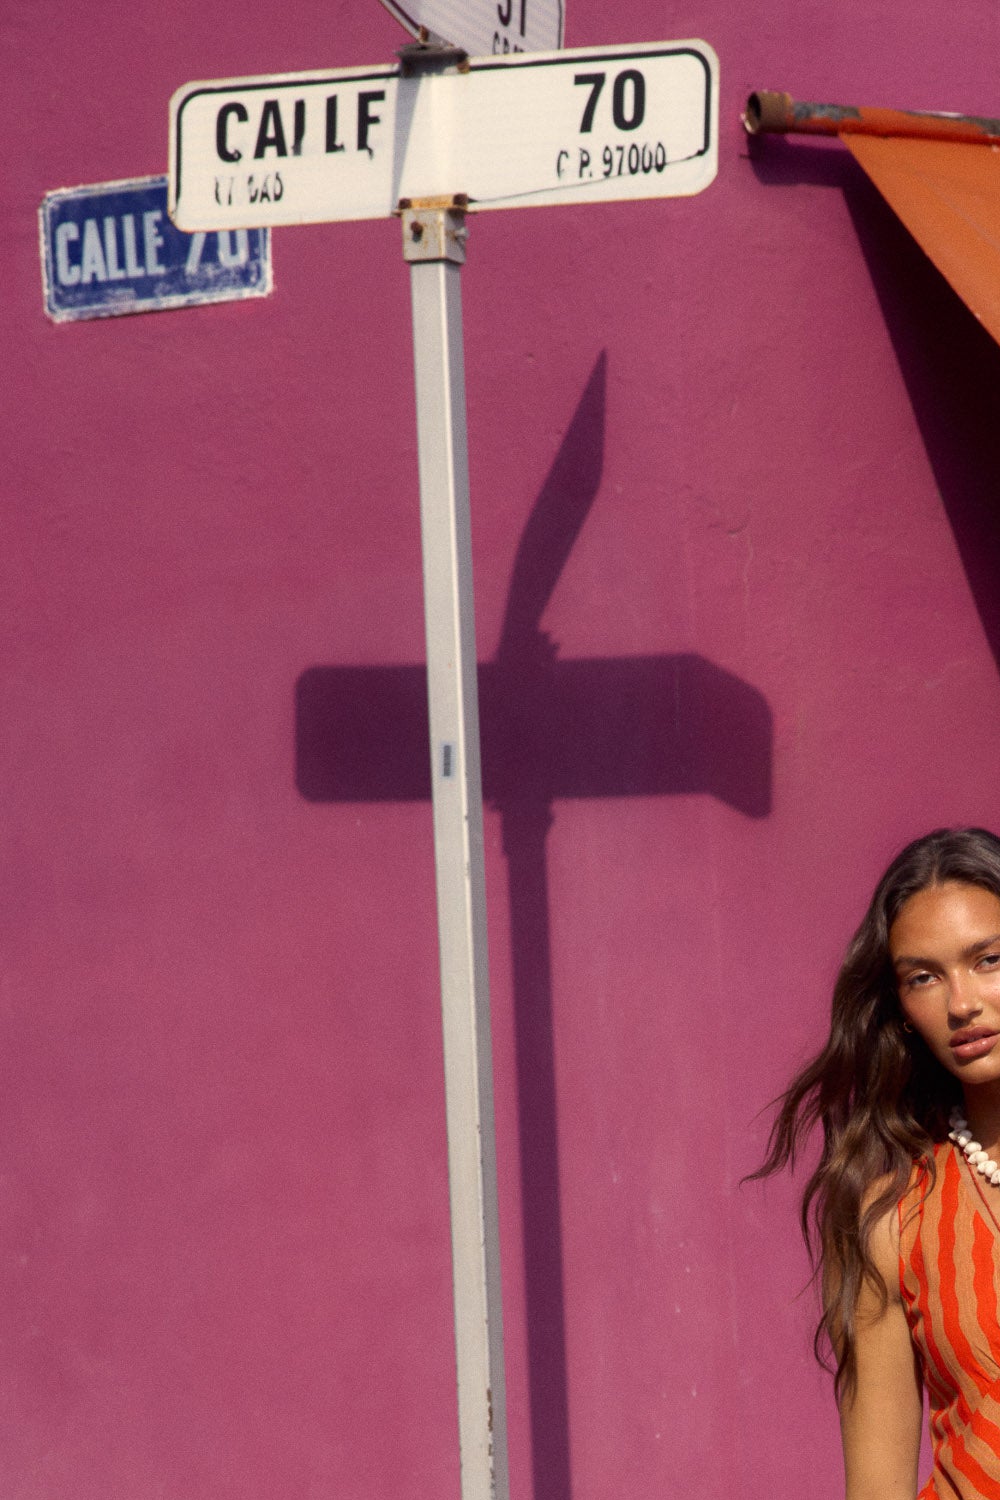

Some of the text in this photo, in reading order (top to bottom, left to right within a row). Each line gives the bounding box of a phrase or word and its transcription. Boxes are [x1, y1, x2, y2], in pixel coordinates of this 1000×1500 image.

[574, 69, 646, 133] 70
[602, 142, 666, 178] 97000
[56, 210, 166, 286] CALLE
